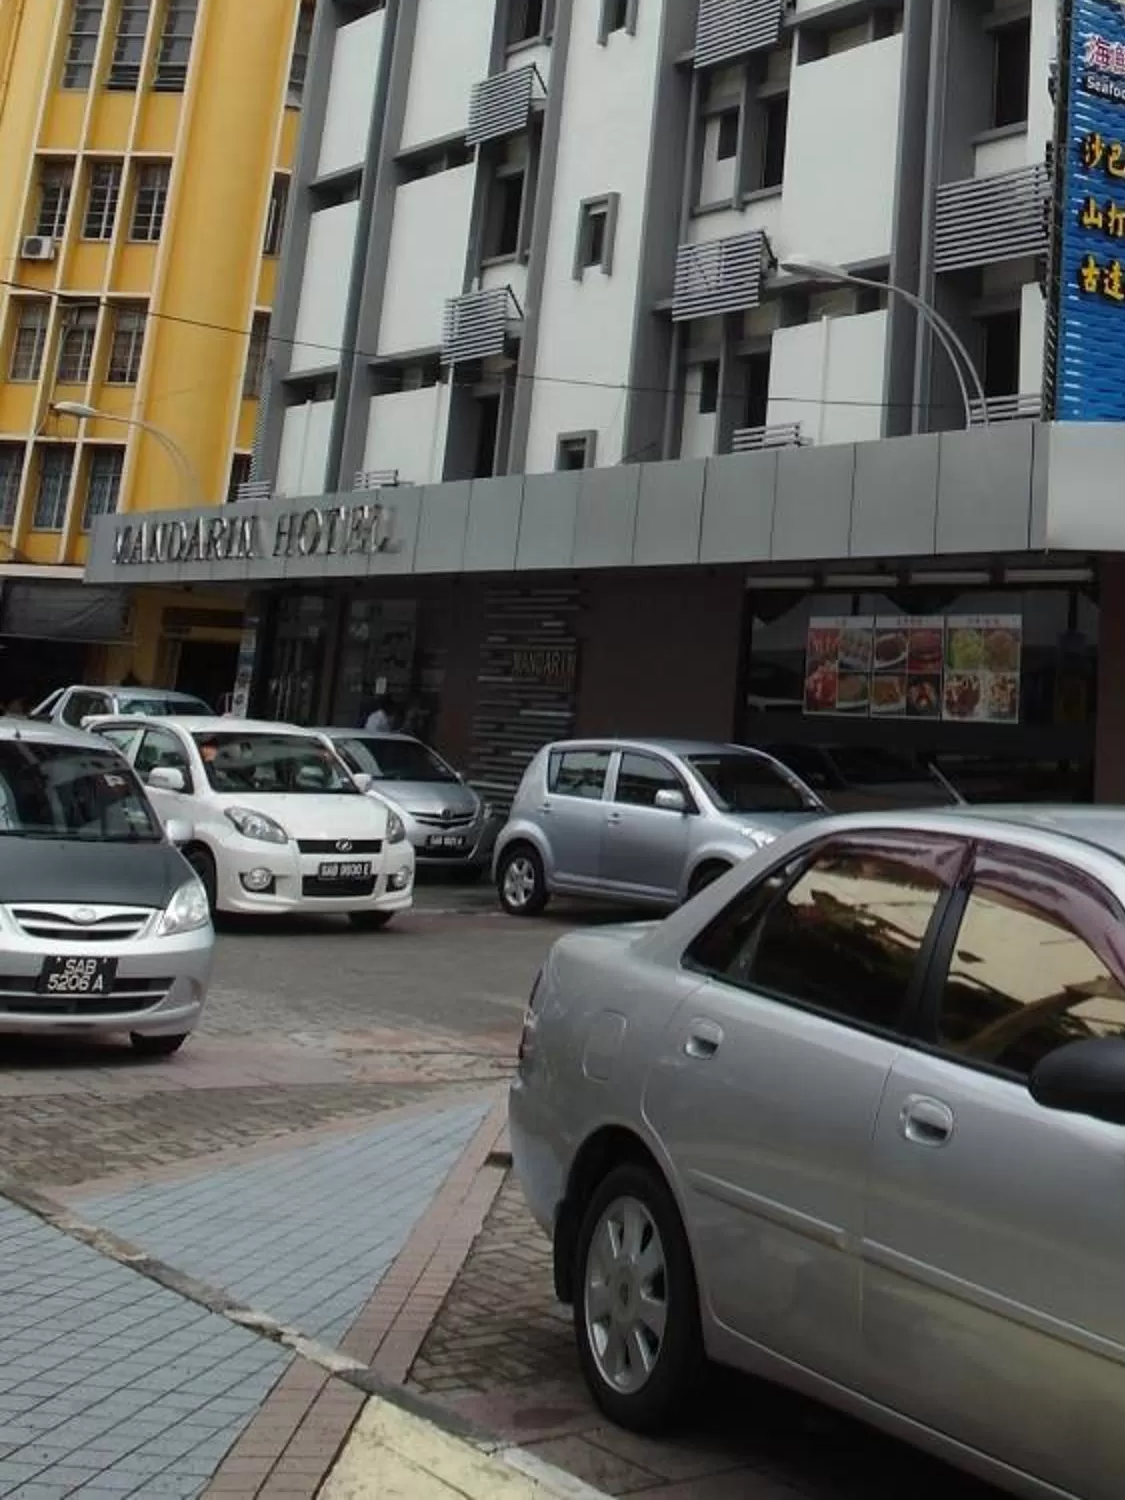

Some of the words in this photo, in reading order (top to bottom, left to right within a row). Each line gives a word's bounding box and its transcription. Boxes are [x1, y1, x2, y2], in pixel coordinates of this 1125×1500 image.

[112, 515, 260, 565] MANDARIN
[272, 503, 396, 557] HOTEL
[64, 958, 97, 975] SAB
[47, 973, 90, 991] 5206
[92, 973, 104, 991] A
